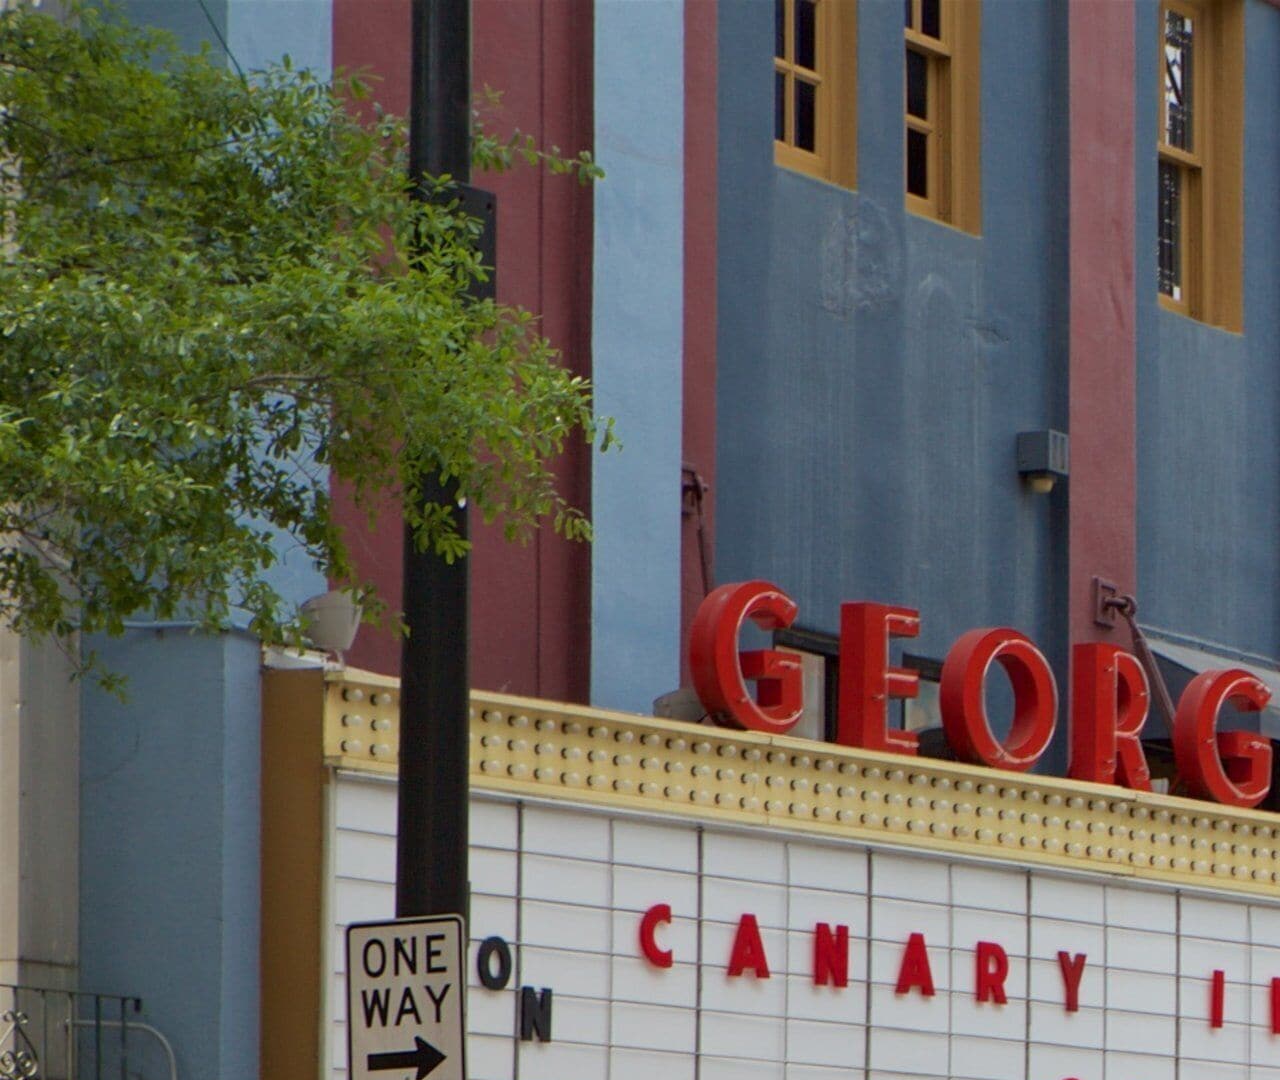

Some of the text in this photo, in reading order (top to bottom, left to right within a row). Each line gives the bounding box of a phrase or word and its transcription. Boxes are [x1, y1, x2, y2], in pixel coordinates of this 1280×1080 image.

[362, 934, 448, 978] ONE
[639, 903, 1087, 1013] CANARY
[361, 983, 451, 1029] WAY
